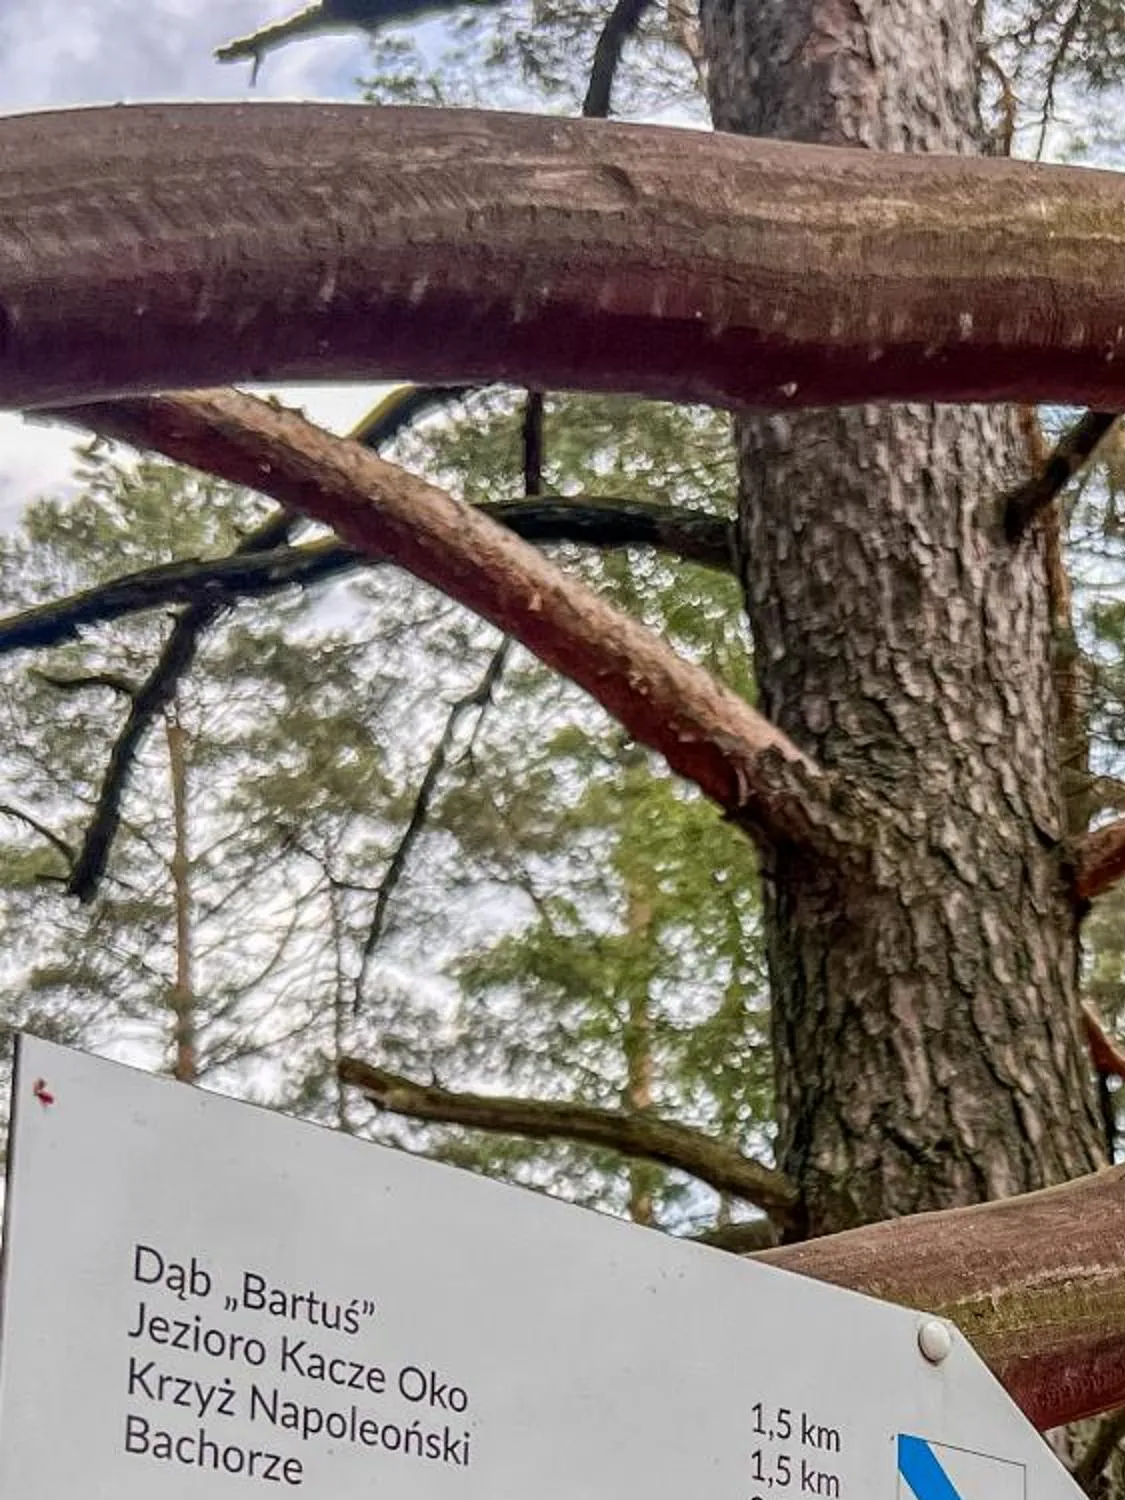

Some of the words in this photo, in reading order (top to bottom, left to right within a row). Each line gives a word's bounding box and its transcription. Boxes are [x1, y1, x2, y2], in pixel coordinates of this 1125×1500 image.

[133, 1244, 211, 1299] Dąb
[128, 1302, 266, 1366] Jezioro
[281, 1336, 385, 1393] Kacze
[399, 1366, 469, 1412] Oko
[128, 1357, 235, 1417] Krzyż
[250, 1384, 471, 1466] Napoleoński
[751, 1402, 791, 1441] 1,5
[801, 1412, 840, 1452] km
[125, 1415, 304, 1485] Bachorze
[751, 1449, 791, 1488] 1,5
[801, 1459, 839, 1499] km
